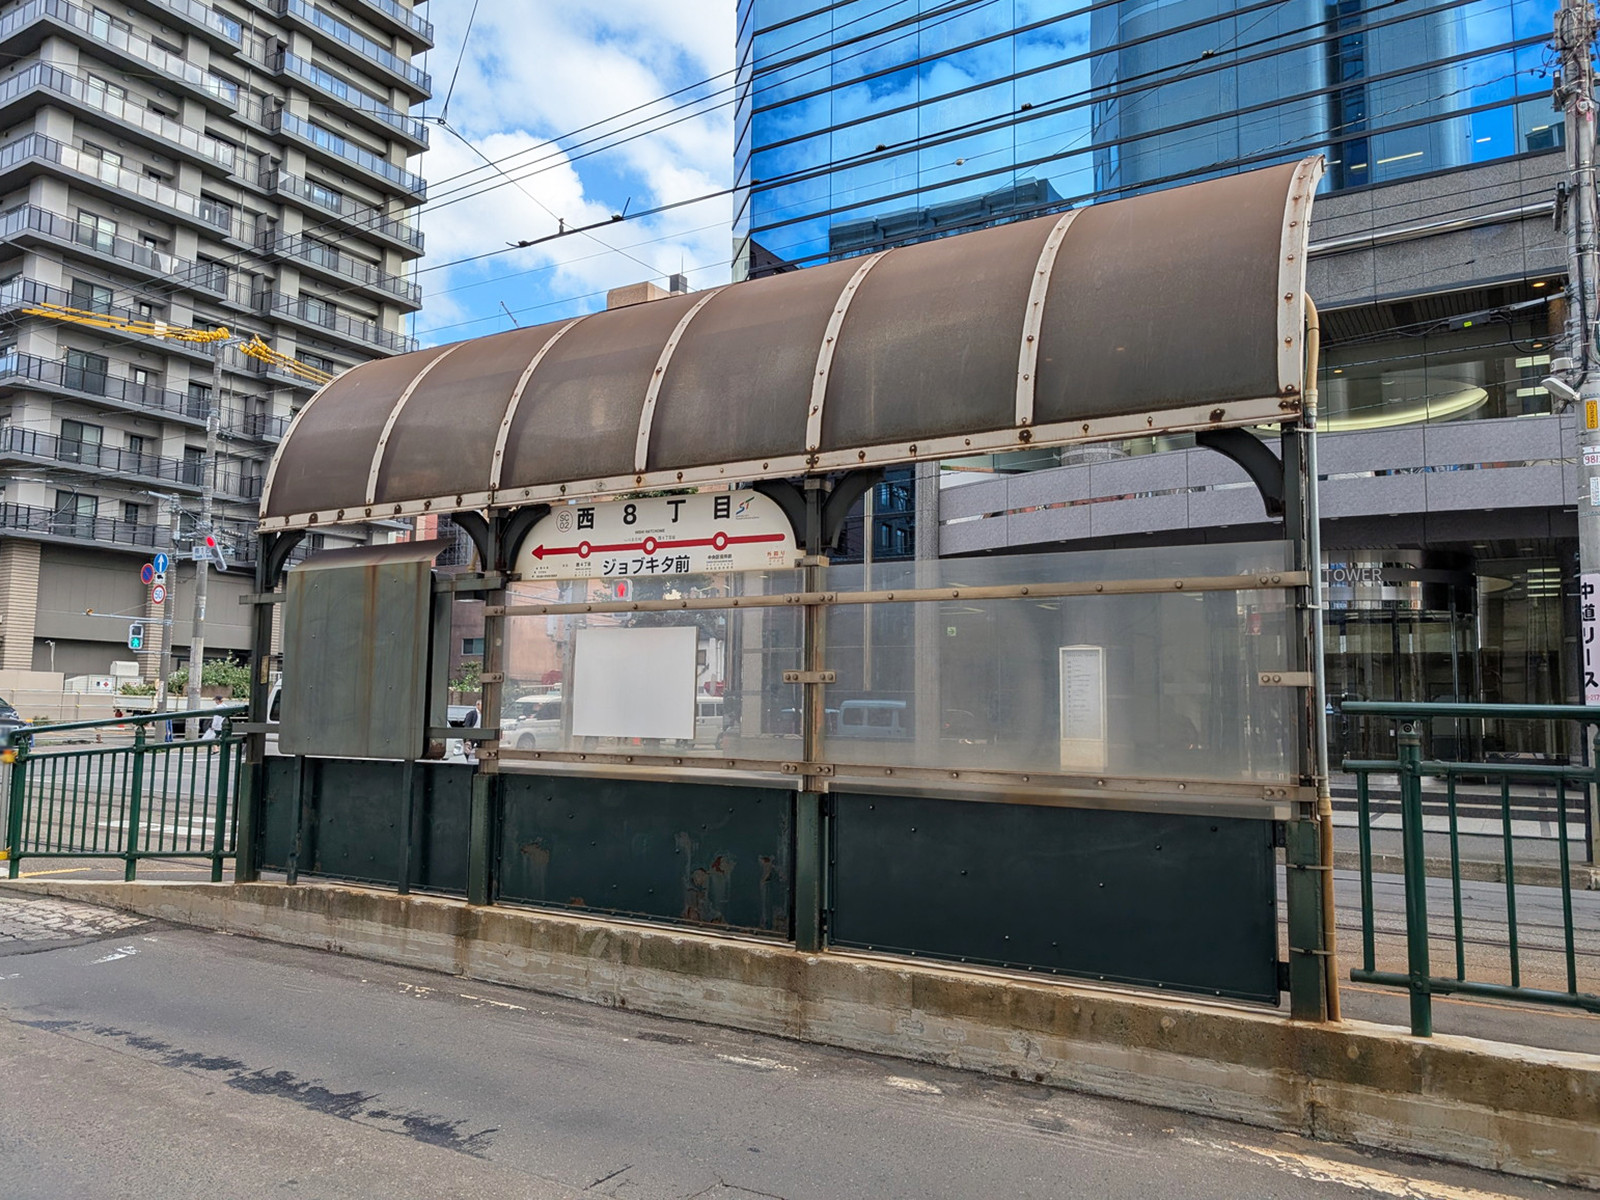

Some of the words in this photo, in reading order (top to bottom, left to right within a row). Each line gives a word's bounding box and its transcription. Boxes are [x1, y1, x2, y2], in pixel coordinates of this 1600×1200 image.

[1584, 454, 1600, 465] 981
[559, 514, 570, 522] SC
[577, 495, 731, 530] 西8丁目
[559, 522, 569, 530] 02
[603, 555, 690, 576] ジョブキタ前
[1323, 568, 1382, 581] TOWER
[1581, 582, 1599, 688] 中道リース
